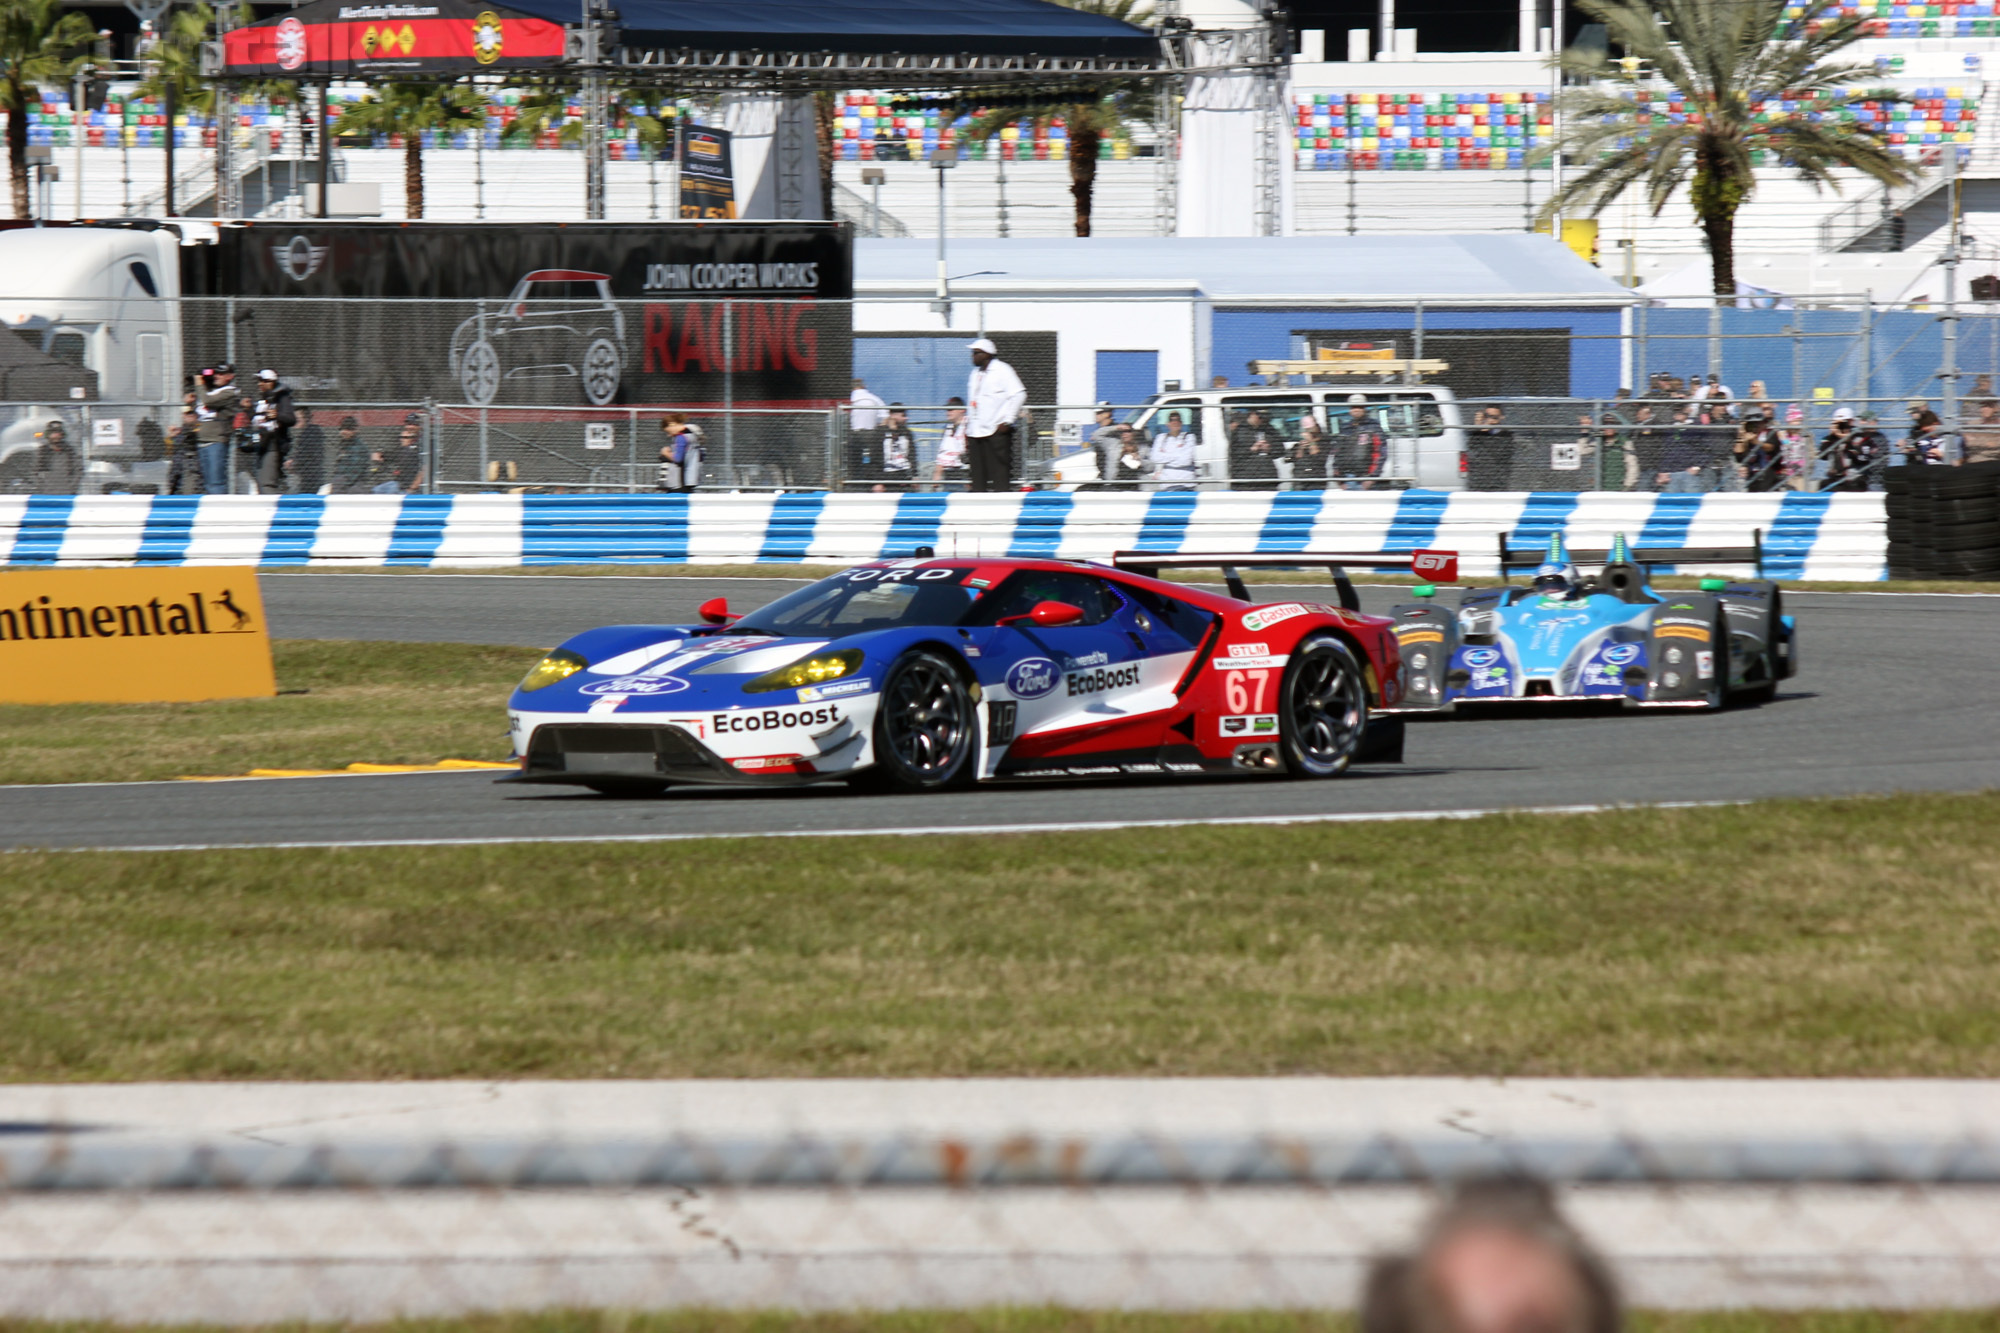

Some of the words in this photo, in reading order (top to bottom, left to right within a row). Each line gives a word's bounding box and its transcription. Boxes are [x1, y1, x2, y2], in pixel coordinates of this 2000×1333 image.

[643, 264, 691, 289] JOHN
[692, 263, 758, 288] COOPER
[758, 262, 819, 288] WORKS
[643, 296, 818, 373] RACING
[1415, 554, 1457, 571] GT
[830, 569, 954, 581] FORD
[1259, 604, 1303, 623] Castrol
[1064, 651, 1098, 667] Powered
[1231, 645, 1268, 656] GTLM
[594, 676, 671, 693] Ford
[1016, 663, 1051, 693] Ford
[1067, 666, 1139, 697] EcoBoost
[821, 681, 870, 695] MICHELIN
[1226, 669, 1270, 714] 67
[713, 704, 838, 733] EcoBoost
